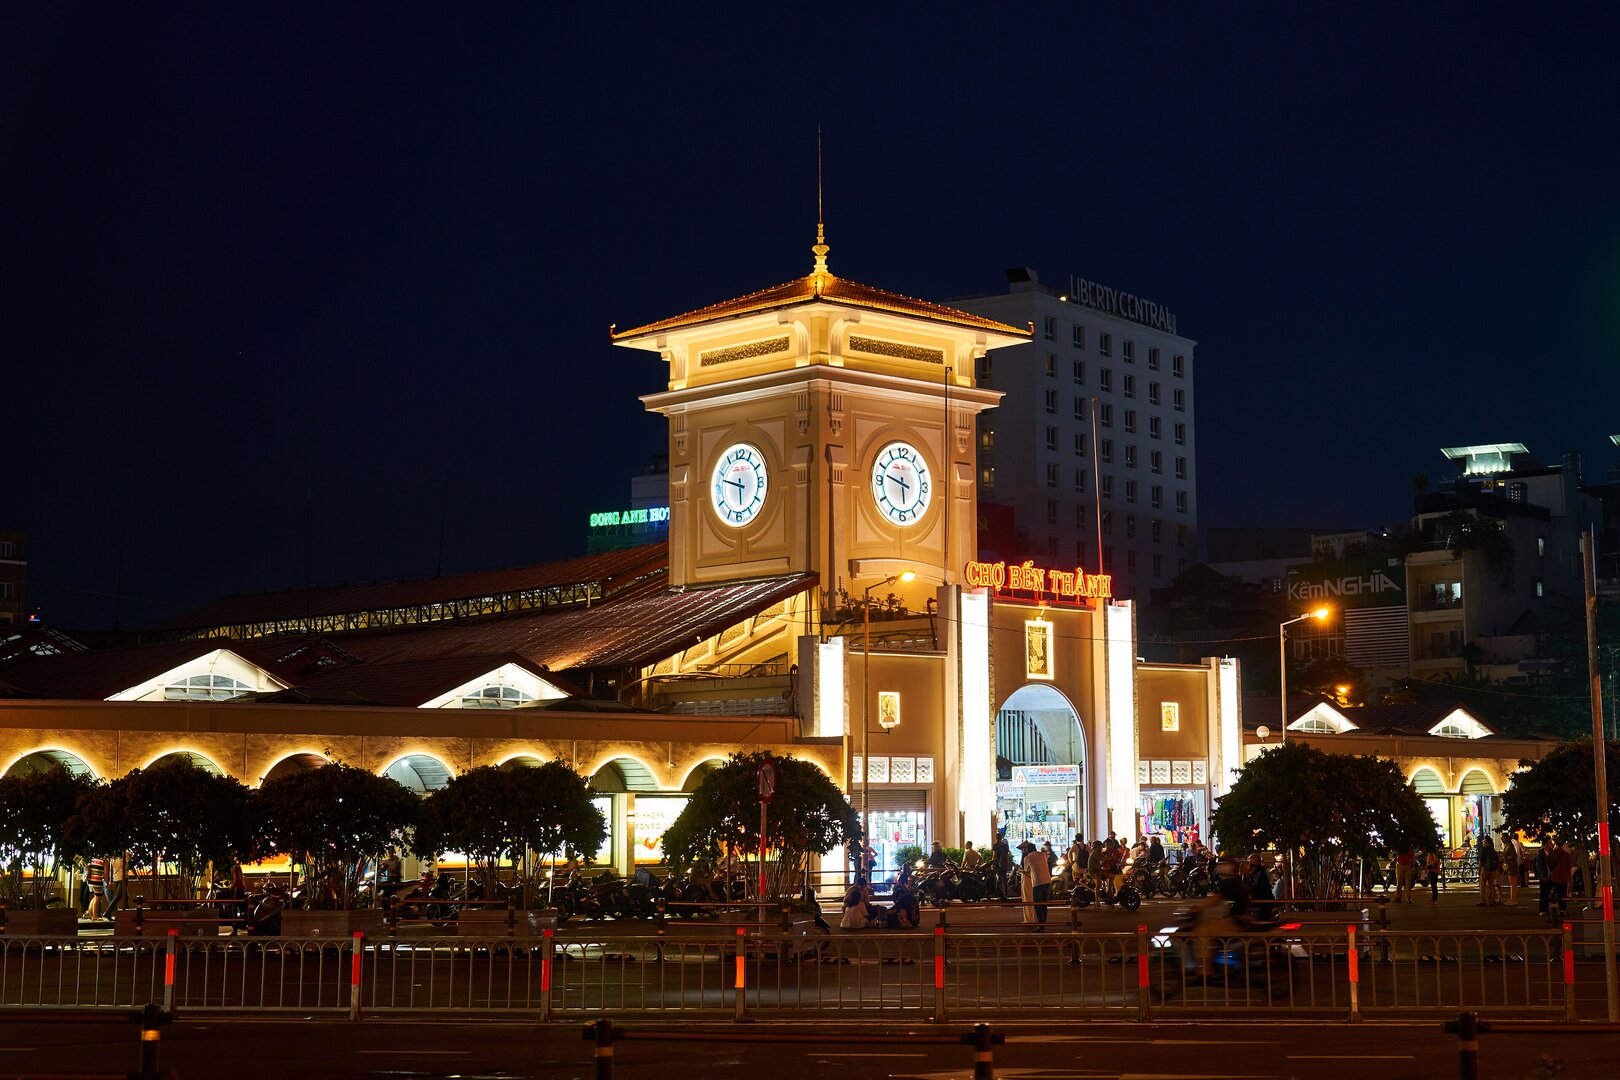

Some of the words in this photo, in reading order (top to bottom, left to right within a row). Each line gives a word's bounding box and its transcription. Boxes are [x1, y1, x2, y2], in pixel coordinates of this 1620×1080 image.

[1070, 274, 1118, 312] LIBERTY
[1119, 290, 1171, 329] CENTRAL
[735, 448, 746, 460] 12
[897, 447, 909, 460] 12
[875, 474, 884, 486] 9
[921, 482, 929, 494] 3
[590, 511, 620, 527] SONG
[621, 509, 648, 524] ANH
[735, 512, 743, 523] 6
[898, 511, 907, 522] 6
[965, 561, 1005, 592] CHỢ
[1009, 560, 1045, 591] BẾN
[1049, 567, 1112, 598] THÀNH
